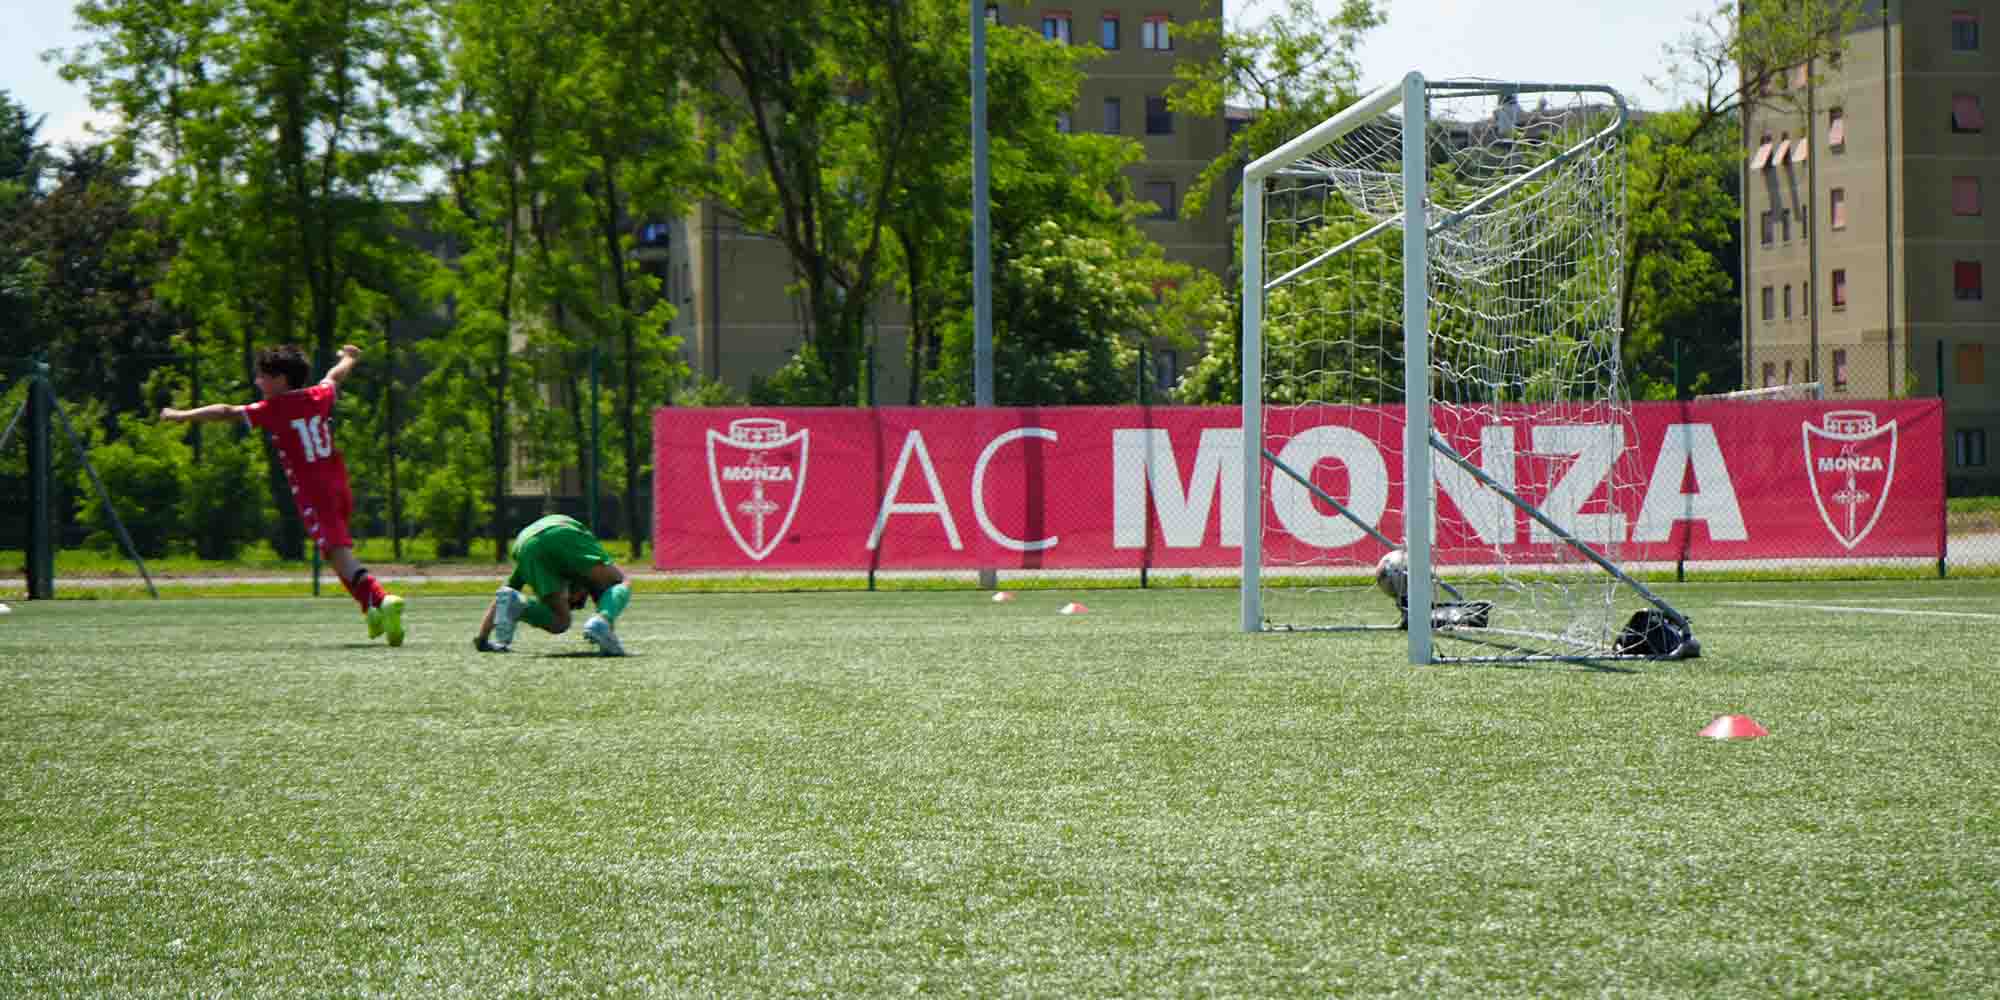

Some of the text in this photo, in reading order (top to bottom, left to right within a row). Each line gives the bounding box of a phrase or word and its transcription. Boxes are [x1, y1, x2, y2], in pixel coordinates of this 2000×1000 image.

[290, 416, 331, 463] 10
[722, 466, 793, 480] MONZA
[1818, 456, 1883, 471] MONZA
[866, 424, 1748, 551] AC MONZA
